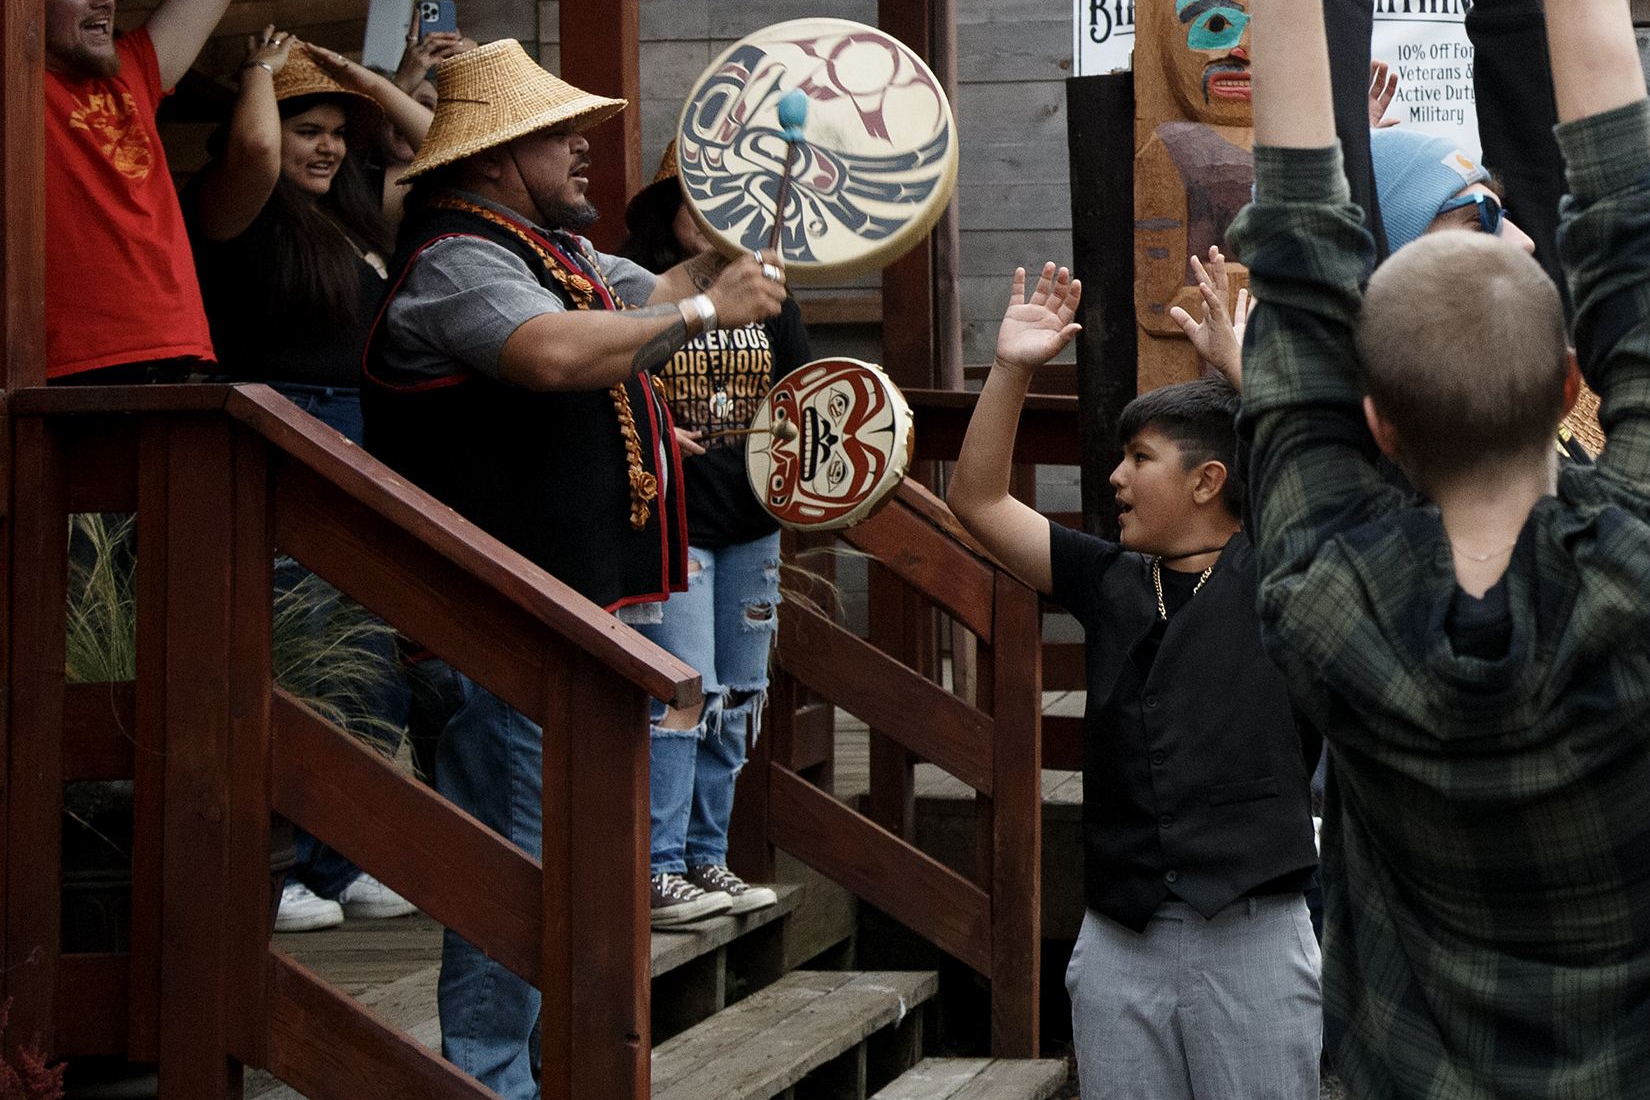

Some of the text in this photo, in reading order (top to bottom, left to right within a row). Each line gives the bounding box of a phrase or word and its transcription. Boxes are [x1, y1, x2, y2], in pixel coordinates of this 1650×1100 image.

[1398, 43, 1474, 60] 10% Off For
[1399, 66, 1461, 81] Veterans
[1396, 86, 1441, 102] Active
[1410, 106, 1464, 125] Military
